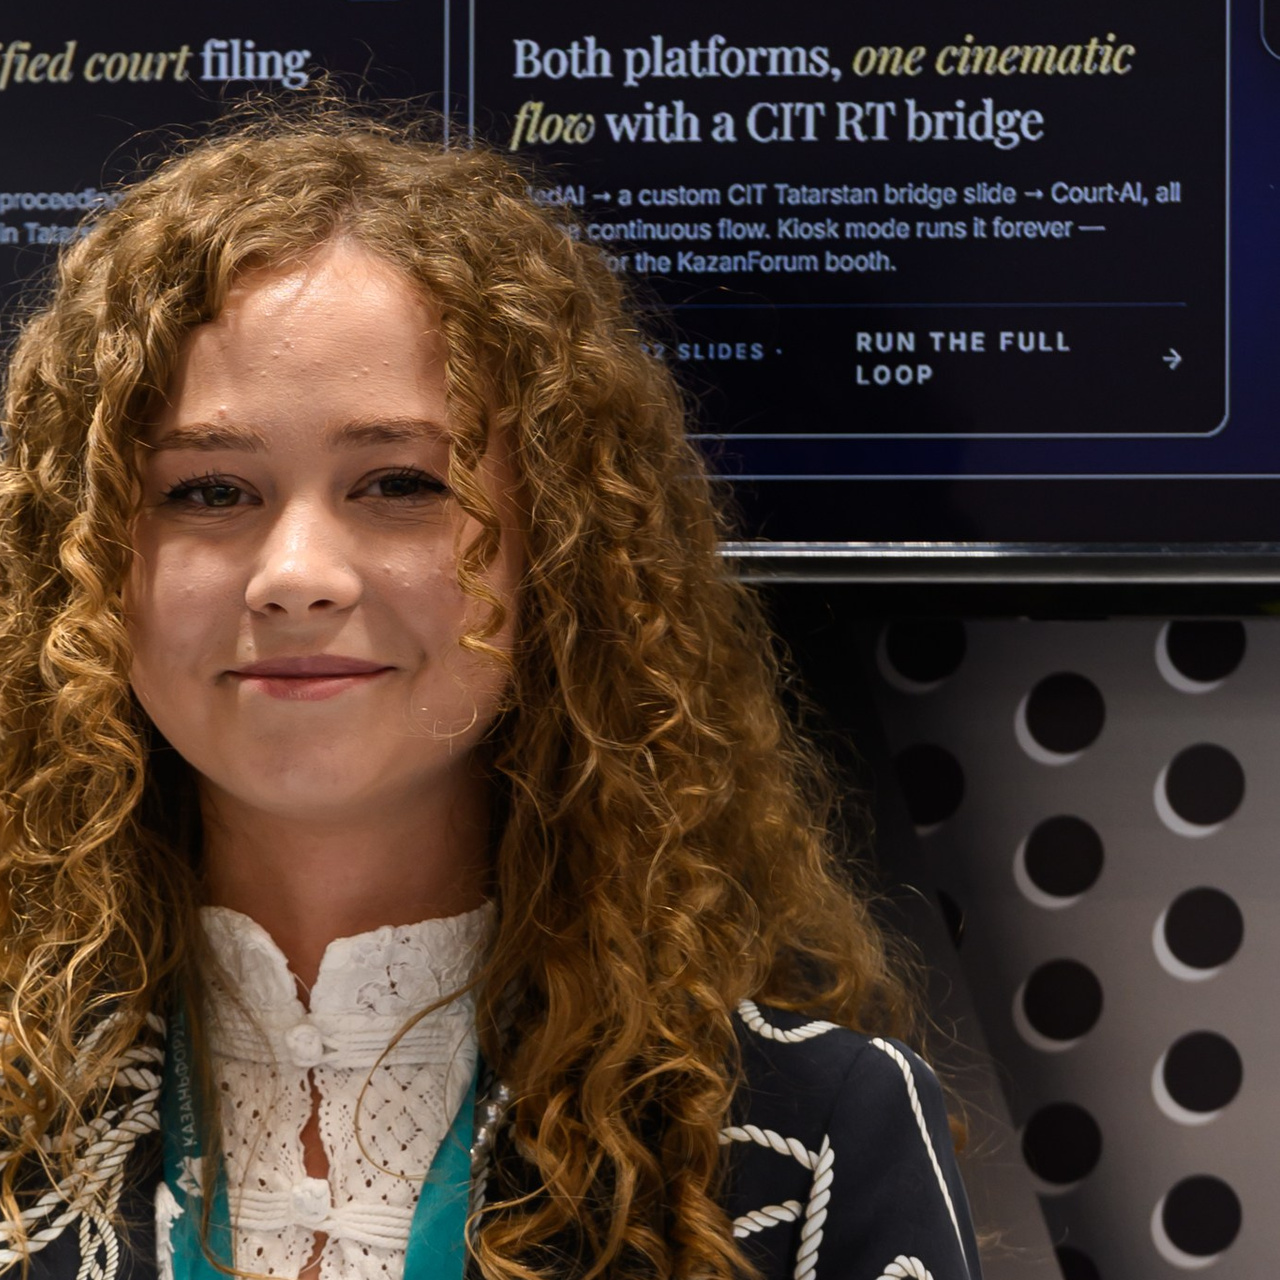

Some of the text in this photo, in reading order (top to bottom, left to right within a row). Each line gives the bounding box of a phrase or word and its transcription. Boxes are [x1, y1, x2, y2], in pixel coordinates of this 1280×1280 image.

[83, 44, 193, 82] court
[200, 38, 313, 90] filing
[513, 33, 1136, 87] Both platforms, one cinematic
[509, 97, 1045, 151] flow with a CIT RT bridge
[617, 189, 633, 207] a
[637, 185, 721, 206] custom
[727, 183, 768, 205] CIT
[773, 183, 879, 205] Tatarstan
[883, 183, 958, 209] bridge
[963, 181, 1017, 204] slide
[1155, 181, 1182, 203] all
[585, 215, 1074, 240] continuous flow. Kiosk mode runs it forever
[634, 250, 897, 273] the KazanForum booth.
[676, 342, 764, 360] SLIDES
[856, 331, 1070, 353] RUN THE FULL
[856, 364, 933, 385] LOOP
